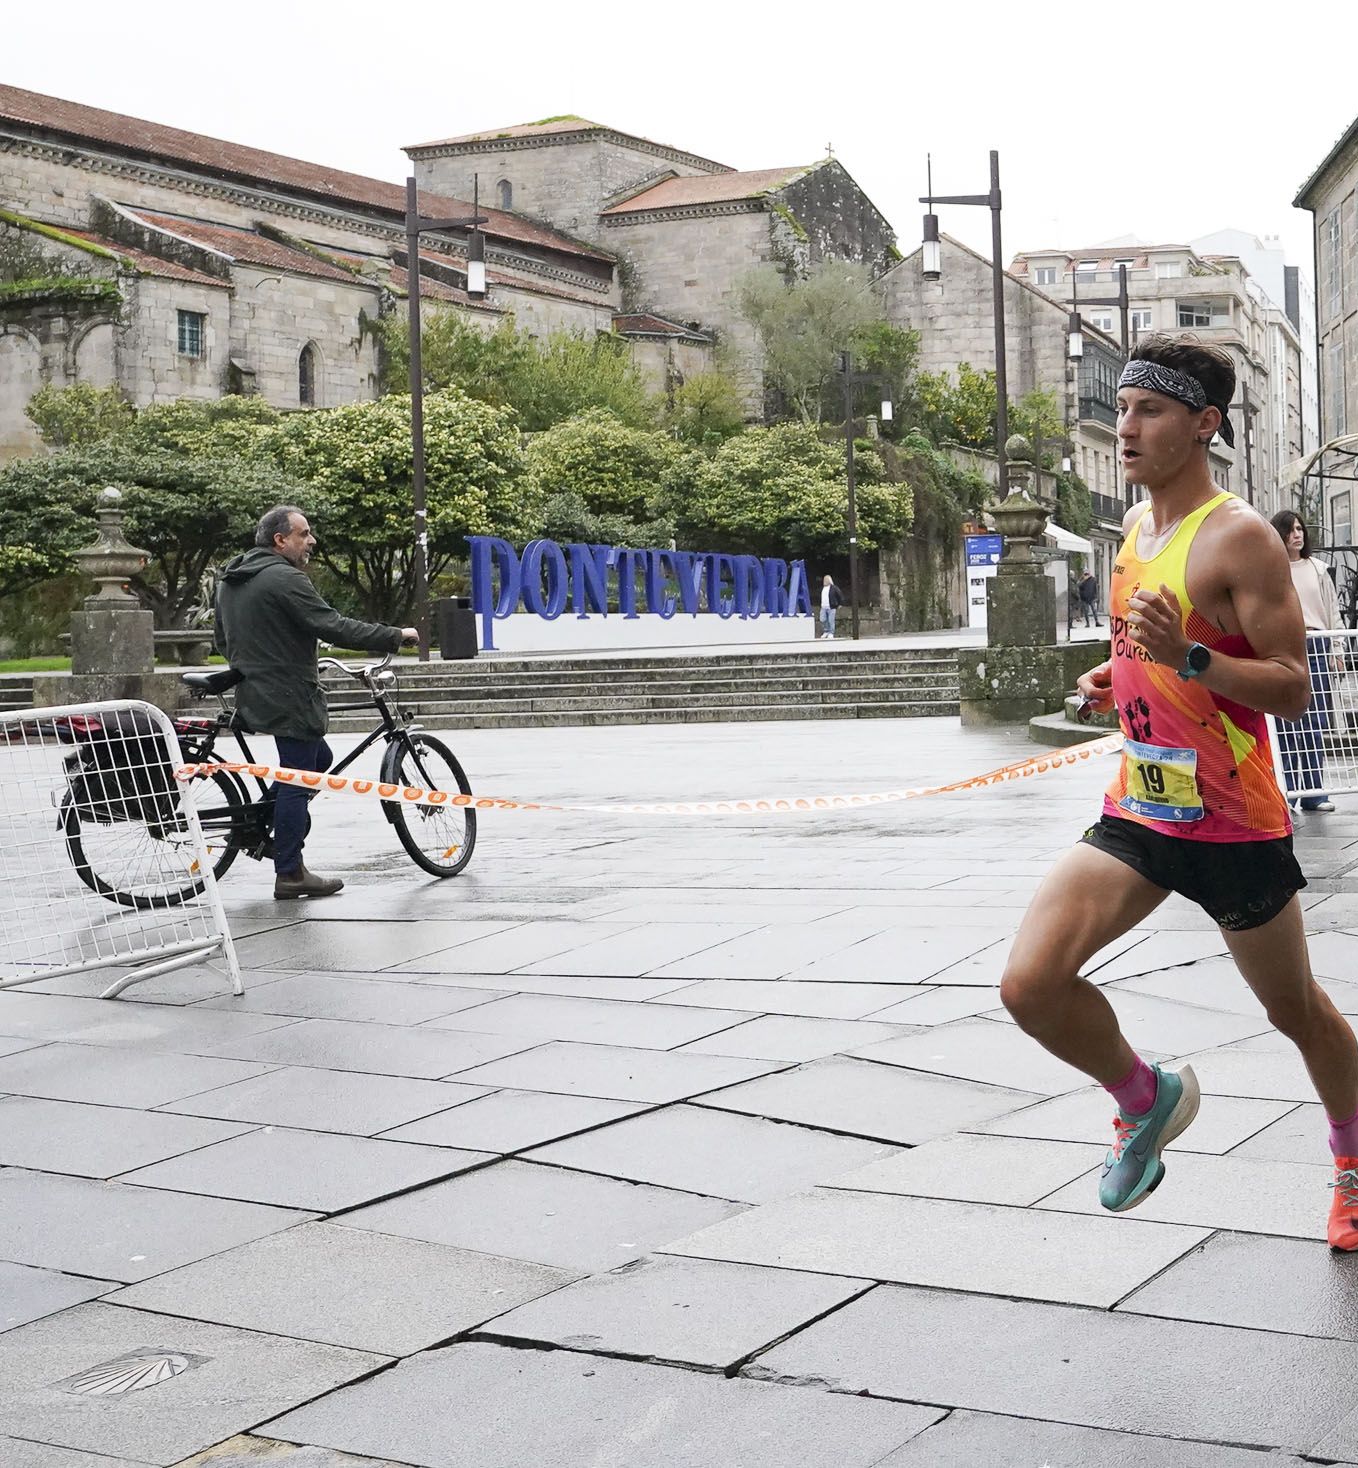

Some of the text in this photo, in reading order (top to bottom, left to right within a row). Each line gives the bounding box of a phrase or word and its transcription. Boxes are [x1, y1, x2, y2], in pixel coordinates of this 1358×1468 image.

[464, 536, 814, 651] PONTEVEDRA
[1116, 638, 1157, 665] Ouren
[1137, 763, 1165, 794] 19
